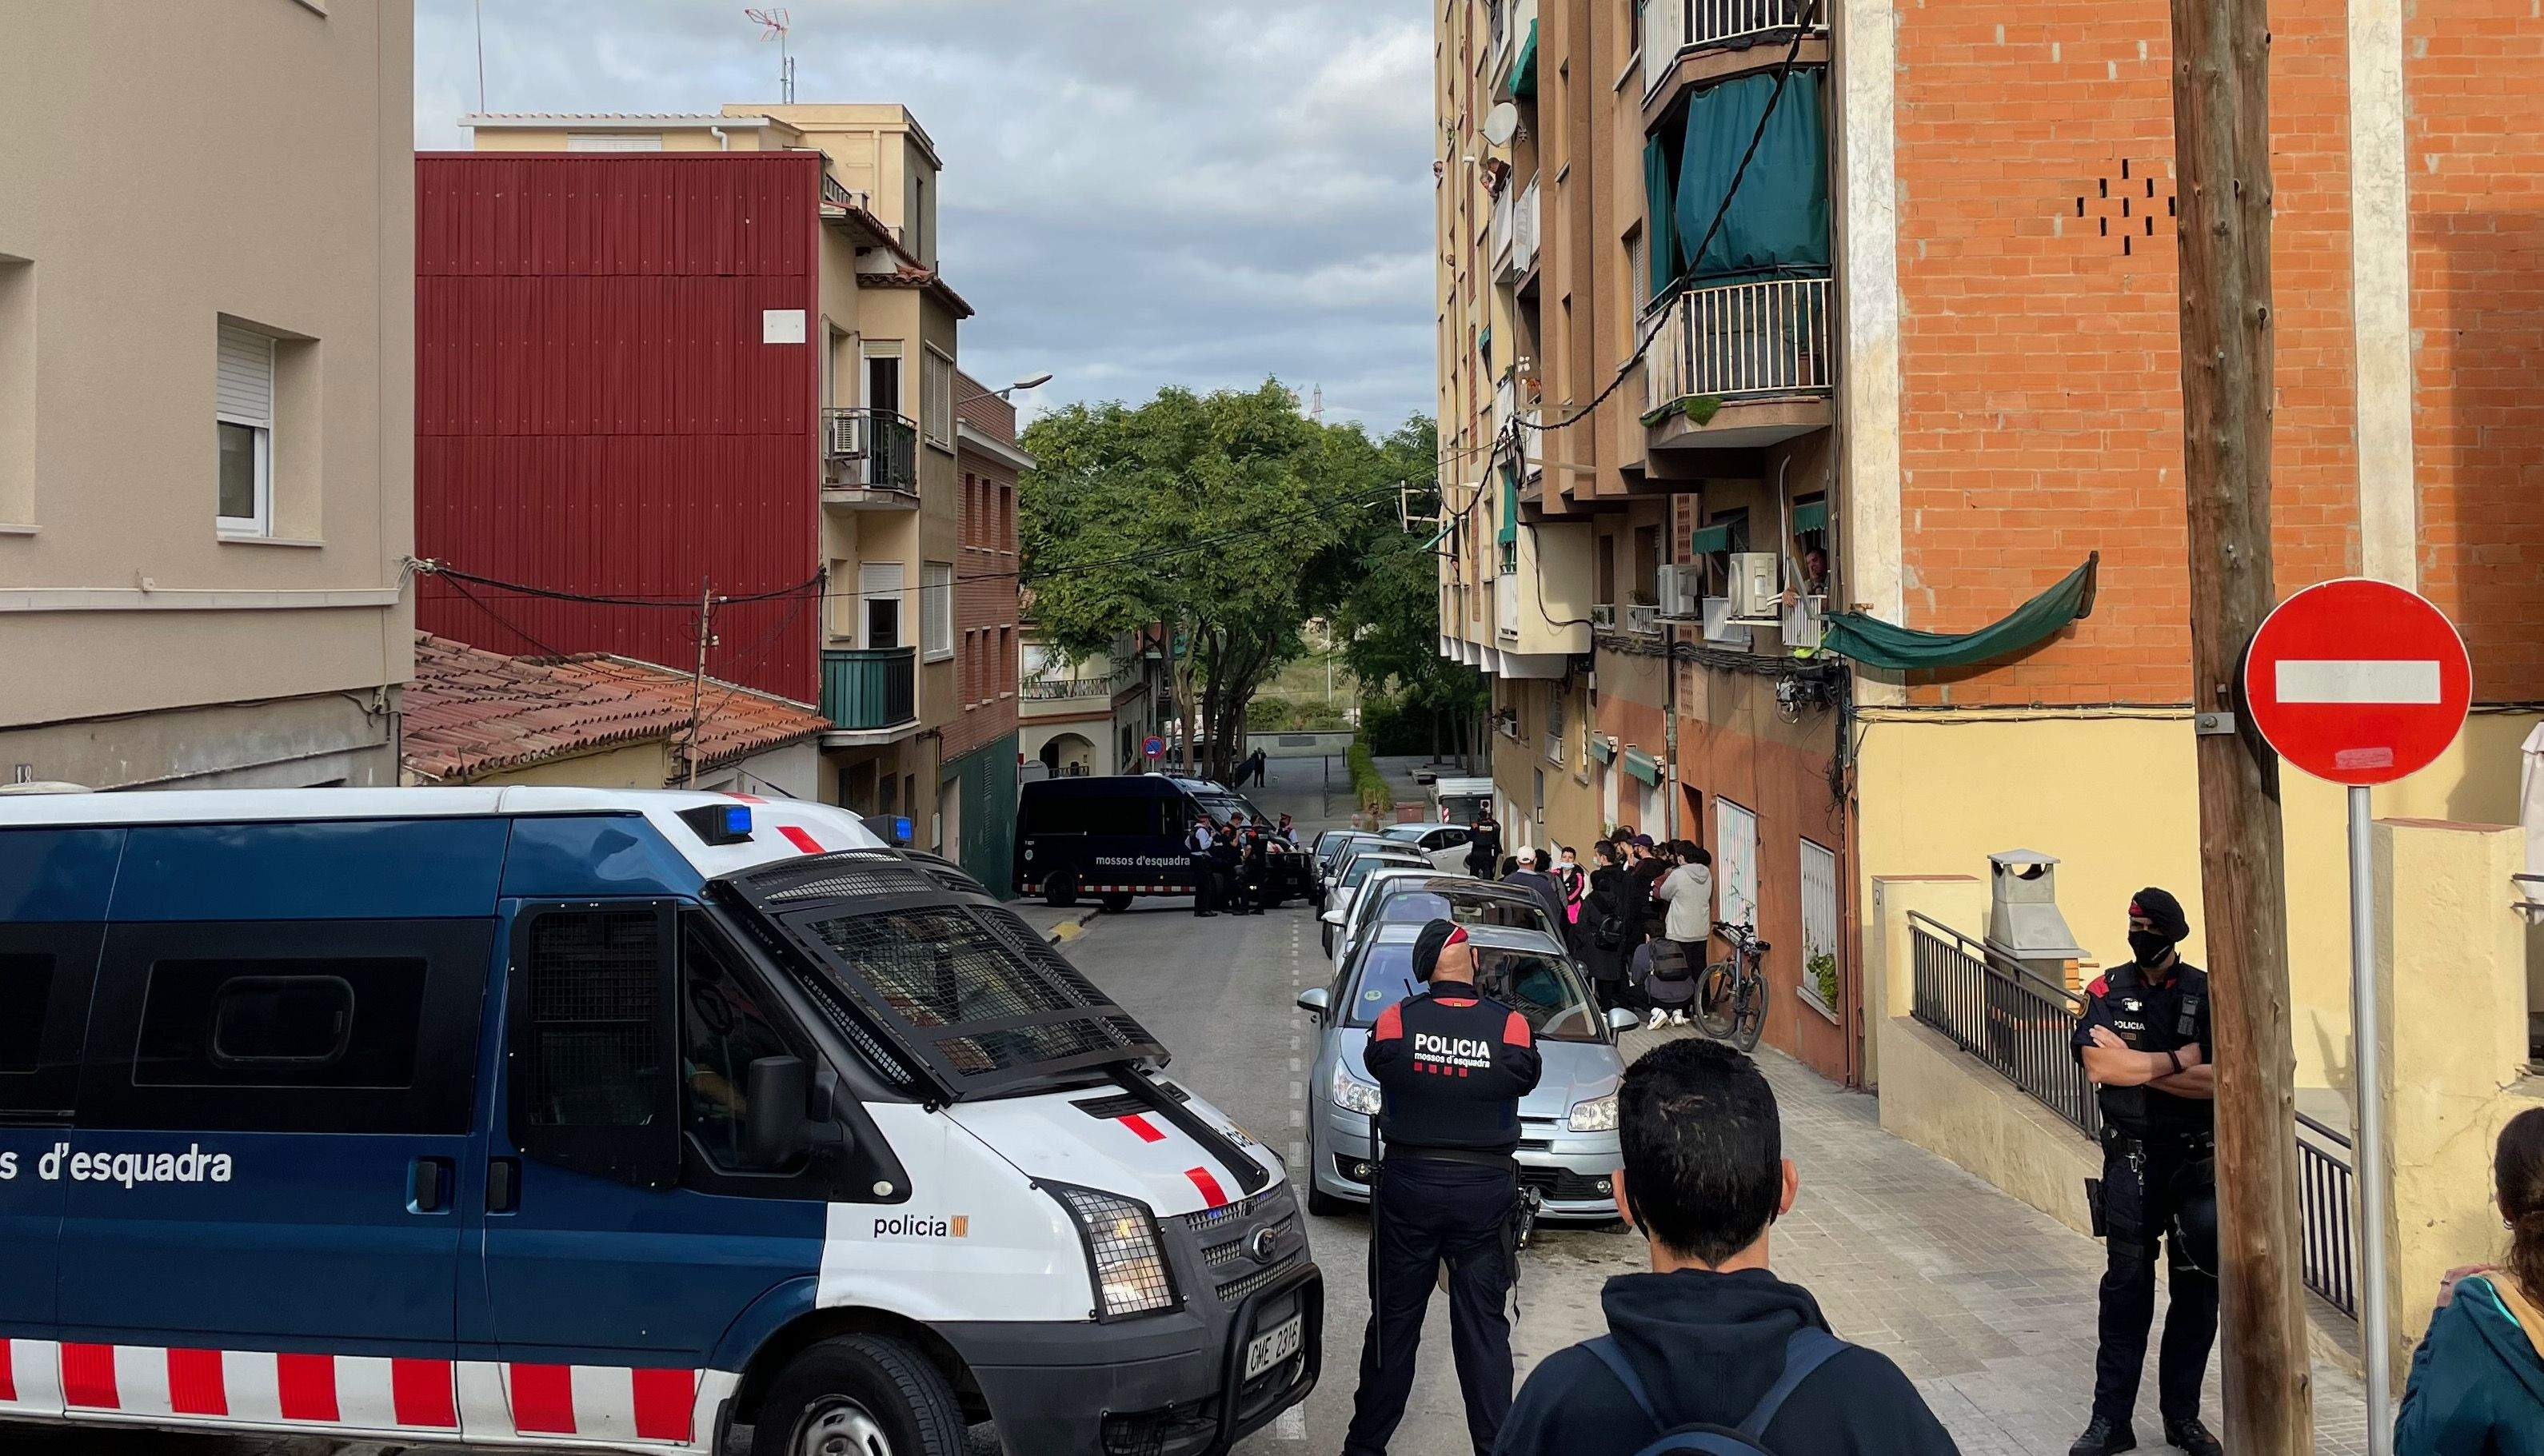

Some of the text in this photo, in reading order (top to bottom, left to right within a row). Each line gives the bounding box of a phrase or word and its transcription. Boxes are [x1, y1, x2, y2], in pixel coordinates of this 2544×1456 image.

[1096, 855, 1190, 868] mossos d'esquadra
[1415, 1033, 1490, 1059] POLICIA
[1414, 1052, 1490, 1068] mossos d'esquadra
[38, 1142, 232, 1189] d'esquadra
[874, 1215, 947, 1238] policia
[1251, 1320, 1298, 1372] CME 2316
